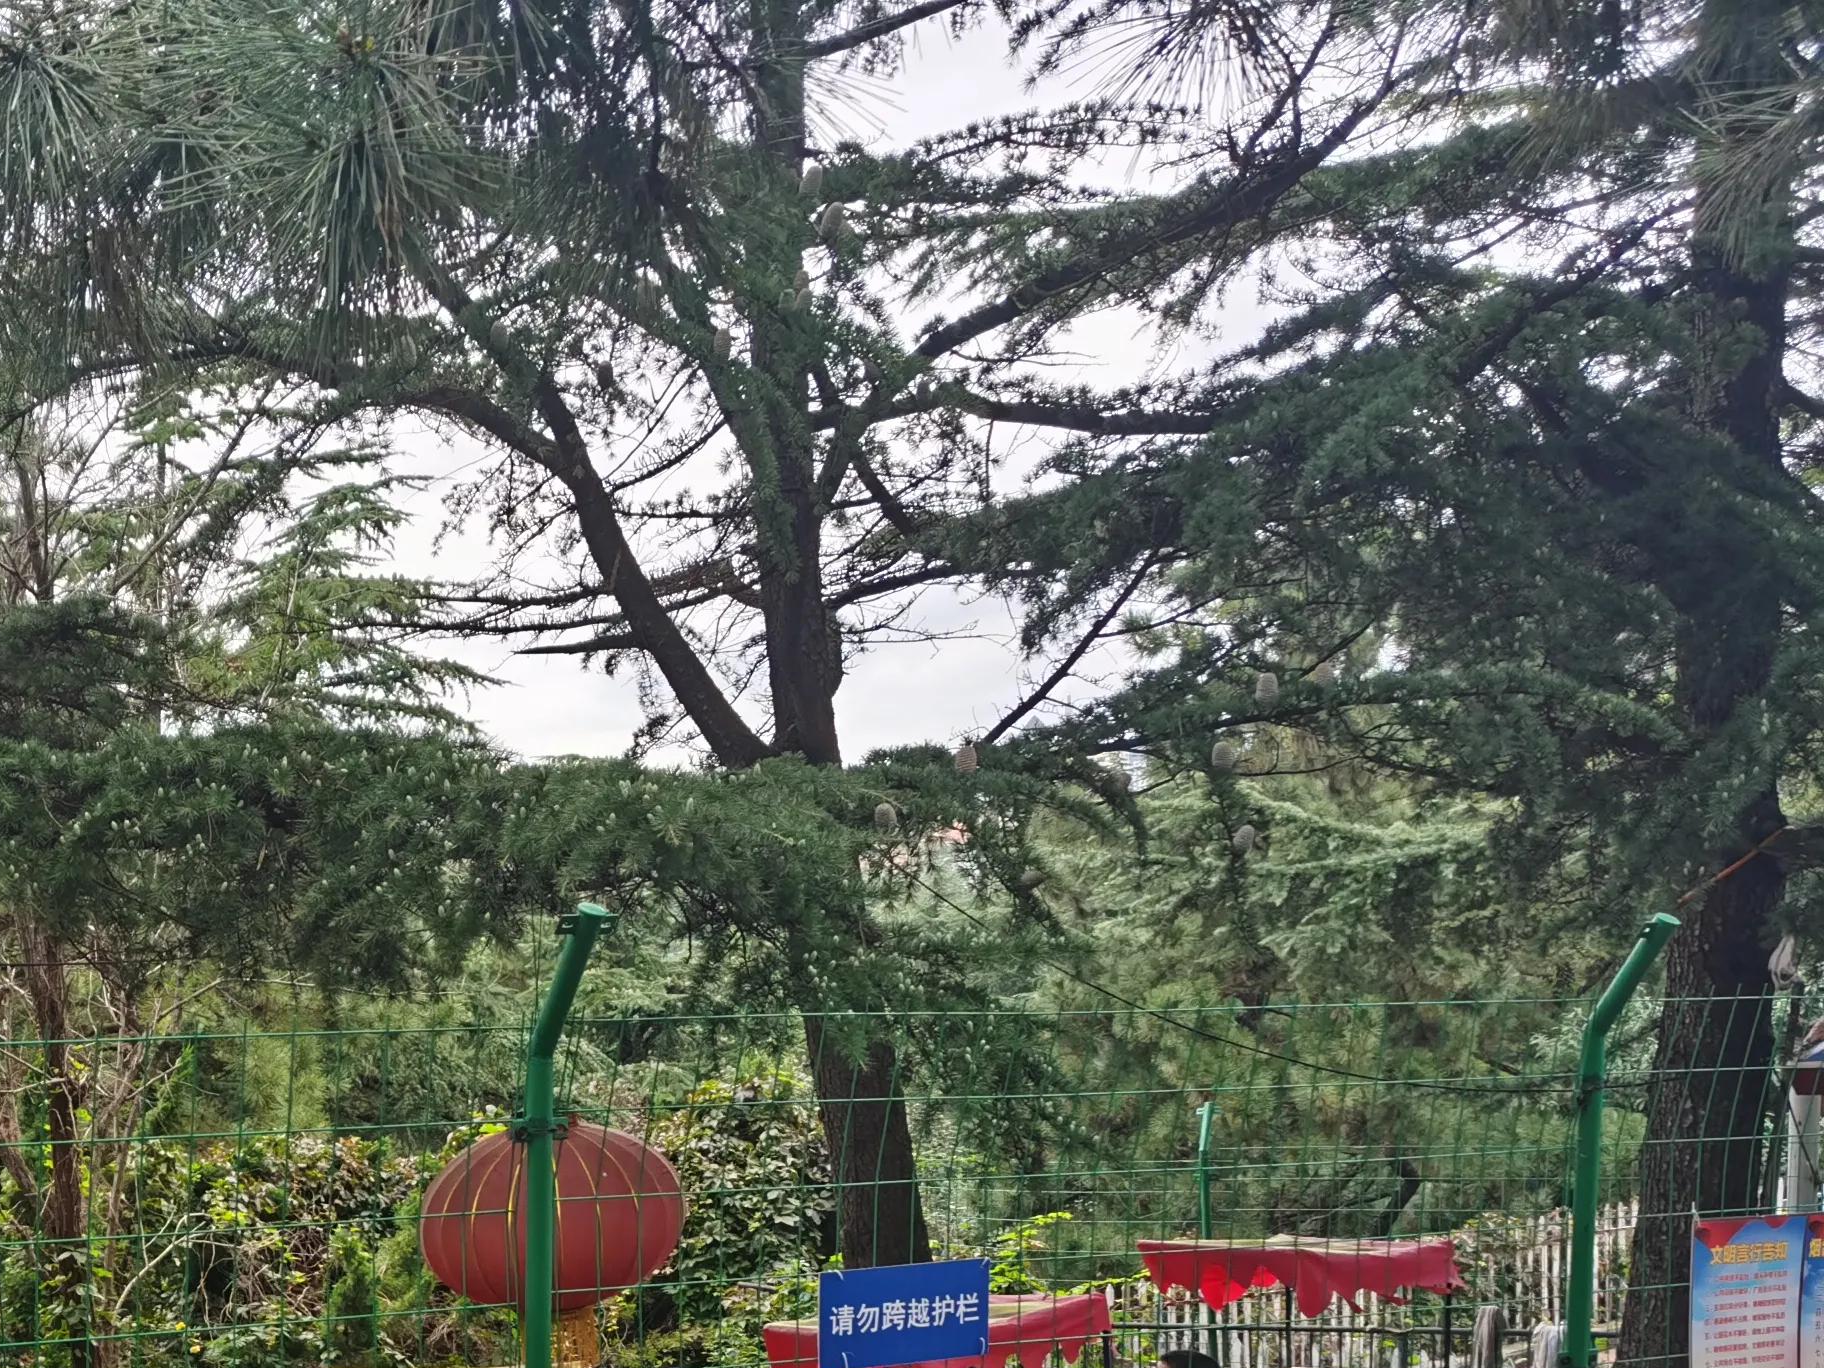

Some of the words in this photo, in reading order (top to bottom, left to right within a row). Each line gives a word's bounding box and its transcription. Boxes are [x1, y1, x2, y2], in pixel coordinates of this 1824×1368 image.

[829, 1292, 980, 1337] 请勿跨越护栏
